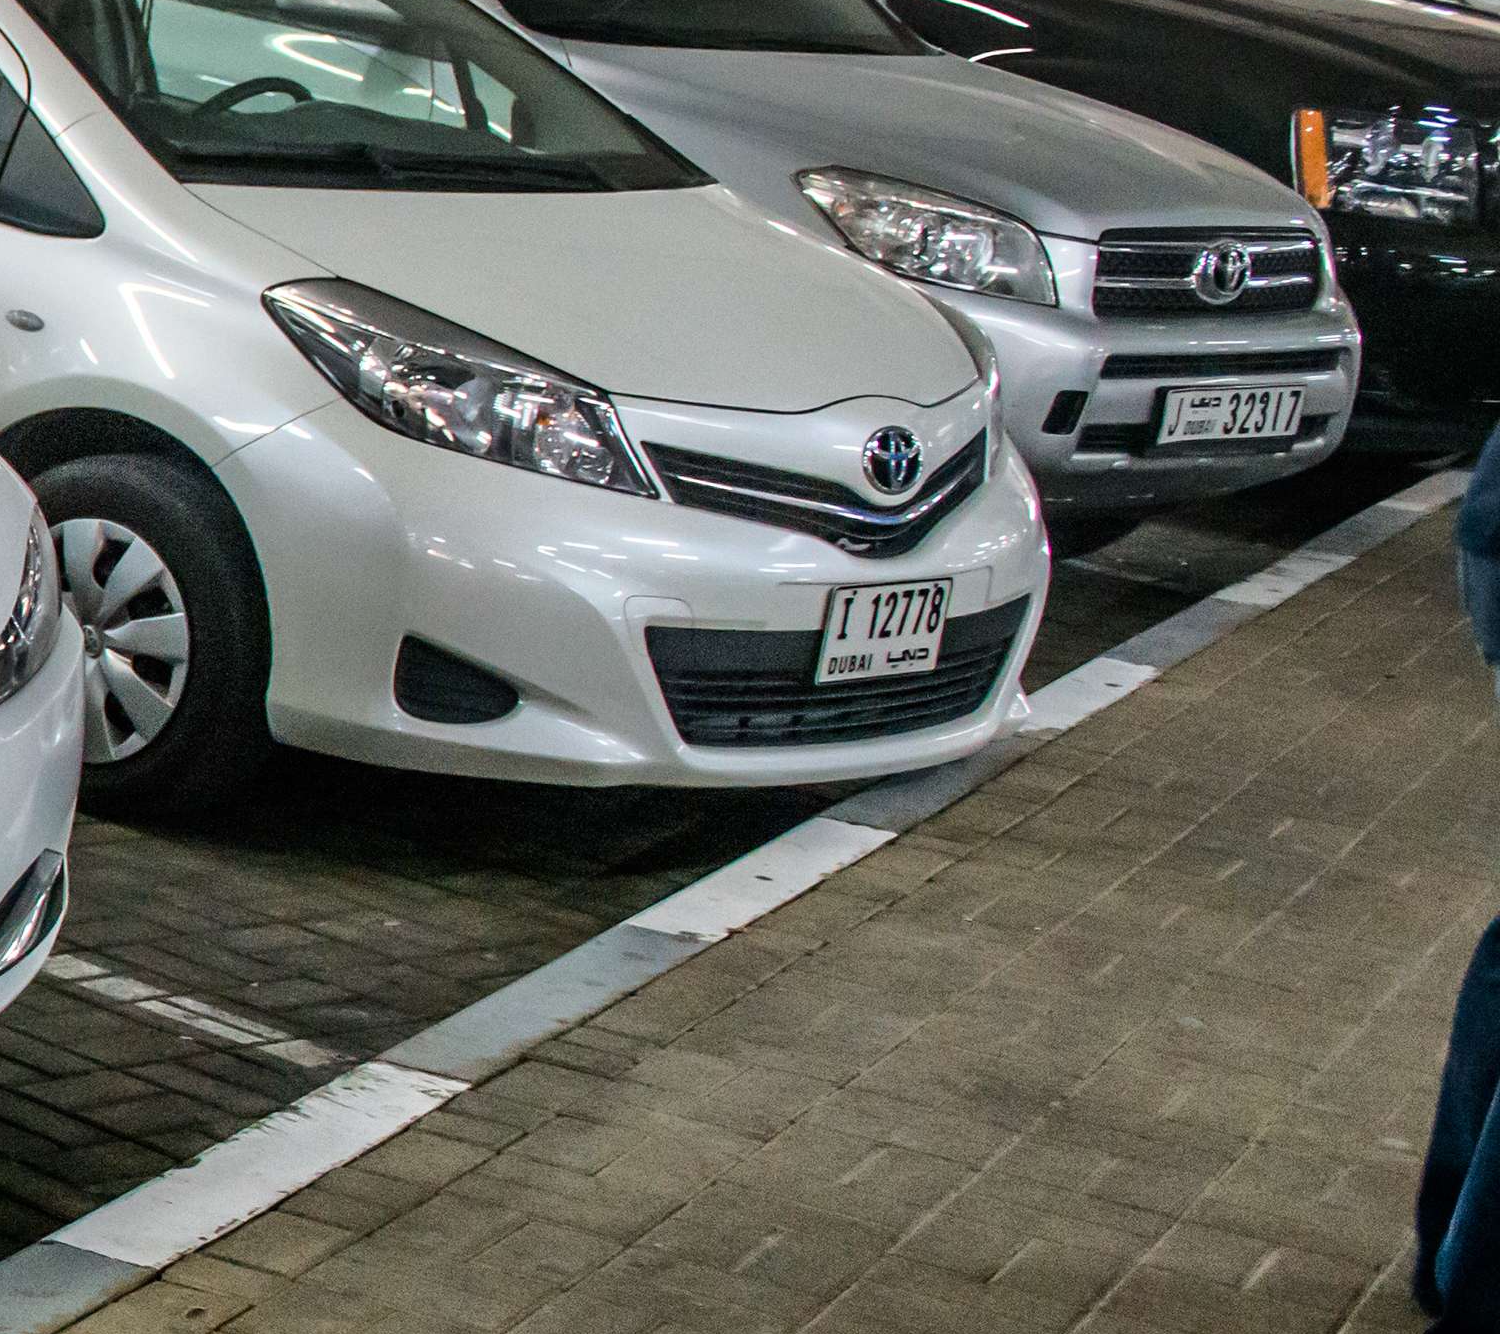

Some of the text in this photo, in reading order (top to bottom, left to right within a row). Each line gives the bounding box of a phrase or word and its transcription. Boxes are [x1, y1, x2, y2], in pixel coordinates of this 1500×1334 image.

[1168, 398, 1183, 436] J
[1183, 419, 1218, 435] DUBAI
[837, 586, 944, 639] I 12778
[827, 654, 873, 675] DUBAI
[886, 648, 929, 668] دبي
